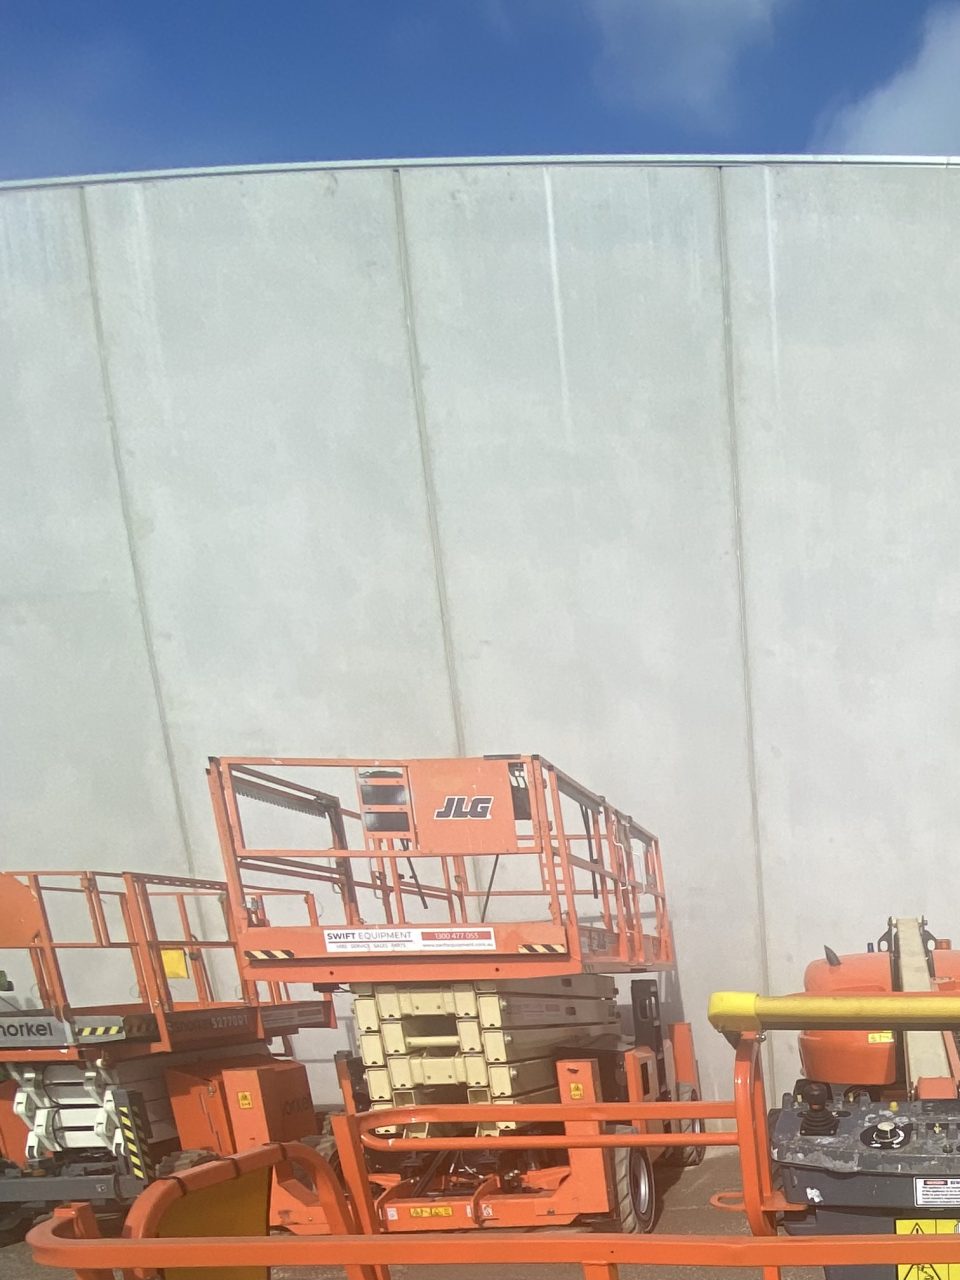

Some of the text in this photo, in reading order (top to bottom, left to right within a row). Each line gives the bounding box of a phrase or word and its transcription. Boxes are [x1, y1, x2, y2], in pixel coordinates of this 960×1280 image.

[433, 796, 494, 820] JLG
[327, 931, 412, 940] SWIFT EQUIPMENT
[434, 932, 450, 940] 1300
